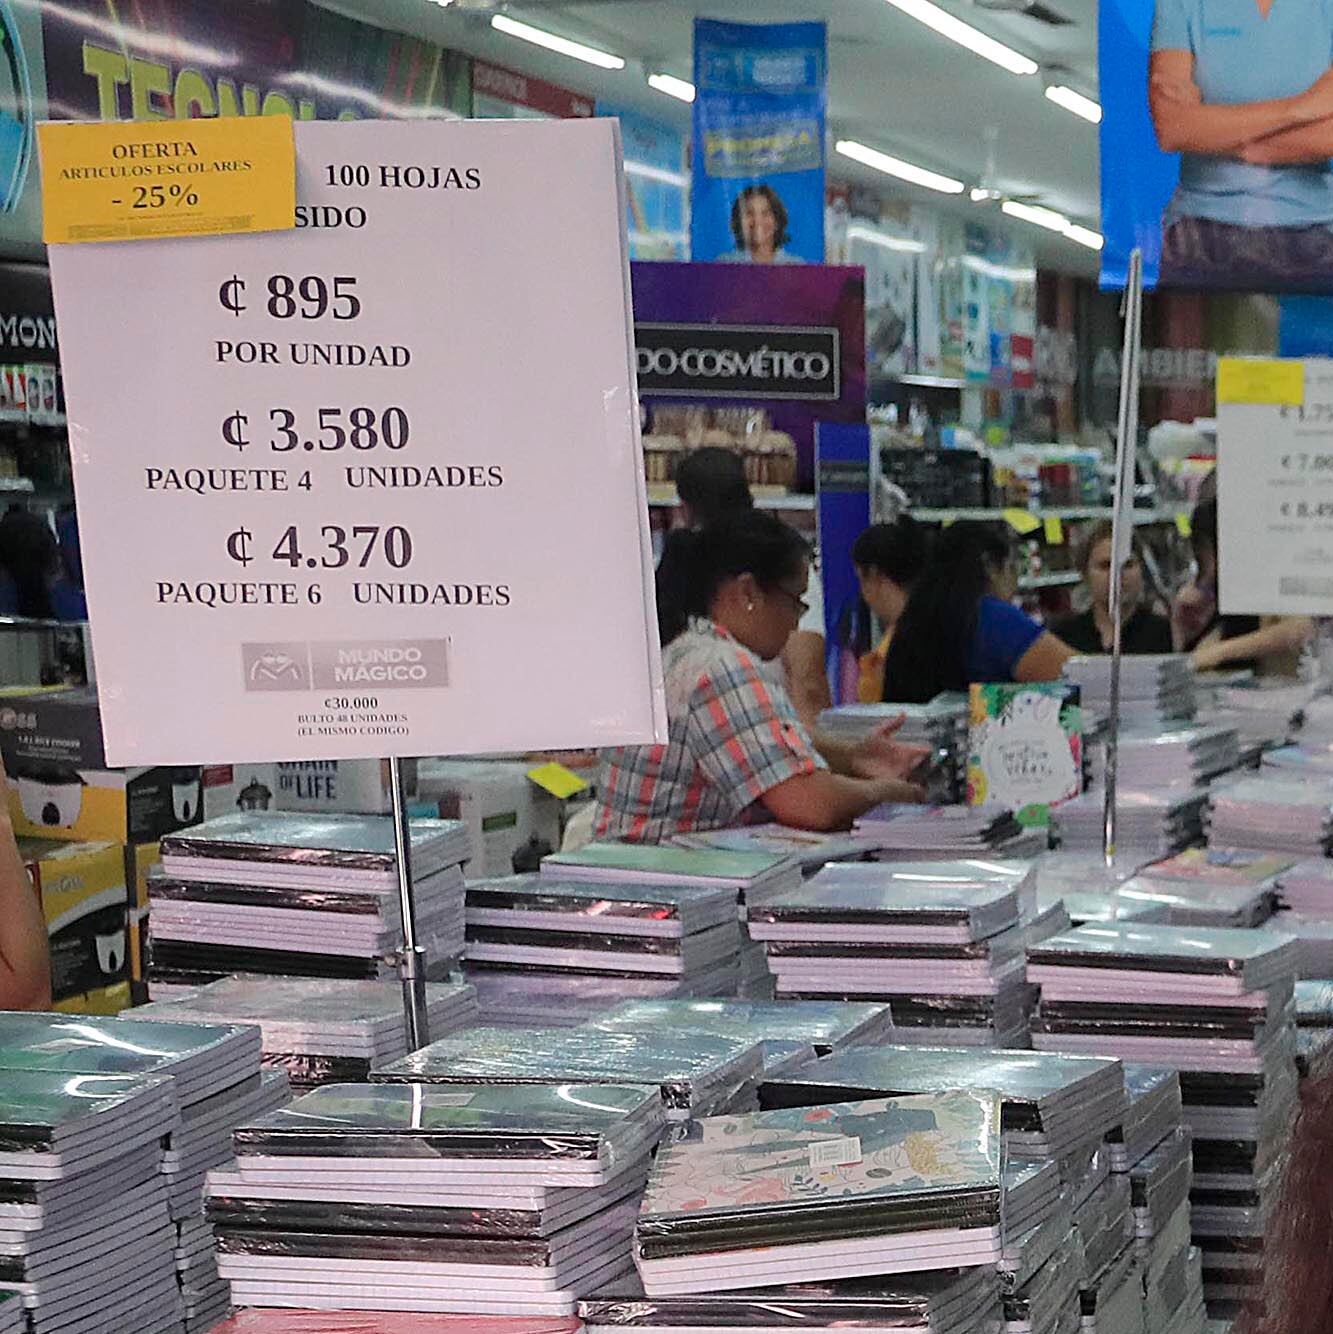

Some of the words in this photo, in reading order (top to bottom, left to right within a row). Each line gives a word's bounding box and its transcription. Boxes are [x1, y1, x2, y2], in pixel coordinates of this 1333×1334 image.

[112, 141, 198, 160] OFERTA
[59, 165, 152, 181] ARTICULOS
[157, 159, 252, 176] ESCOLARES
[324, 163, 371, 188] 100
[379, 163, 482, 191] HOJAS
[132, 183, 199, 209] 25%
[266, 274, 362, 321] 895
[215, 340, 280, 366] POR
[290, 343, 412, 368] UNIDAD
[680, 344, 830, 380] COSMÉTICO
[269, 406, 411, 453] 3.580
[145, 466, 290, 495] PAQUETE
[296, 469, 313, 491] 4
[344, 465, 504, 490] UNIDADES
[271, 524, 414, 570] 4.370
[156, 580, 301, 609] PAQUETE
[306, 581, 322, 605] 6
[352, 581, 512, 607] UNIDADES
[339, 647, 422, 664] MUNDO
[297, 713, 335, 724] BULTO
[350, 713, 408, 724] UNIDADES
[319, 726, 357, 737] MISMO
[296, 774, 337, 800] LIFE
